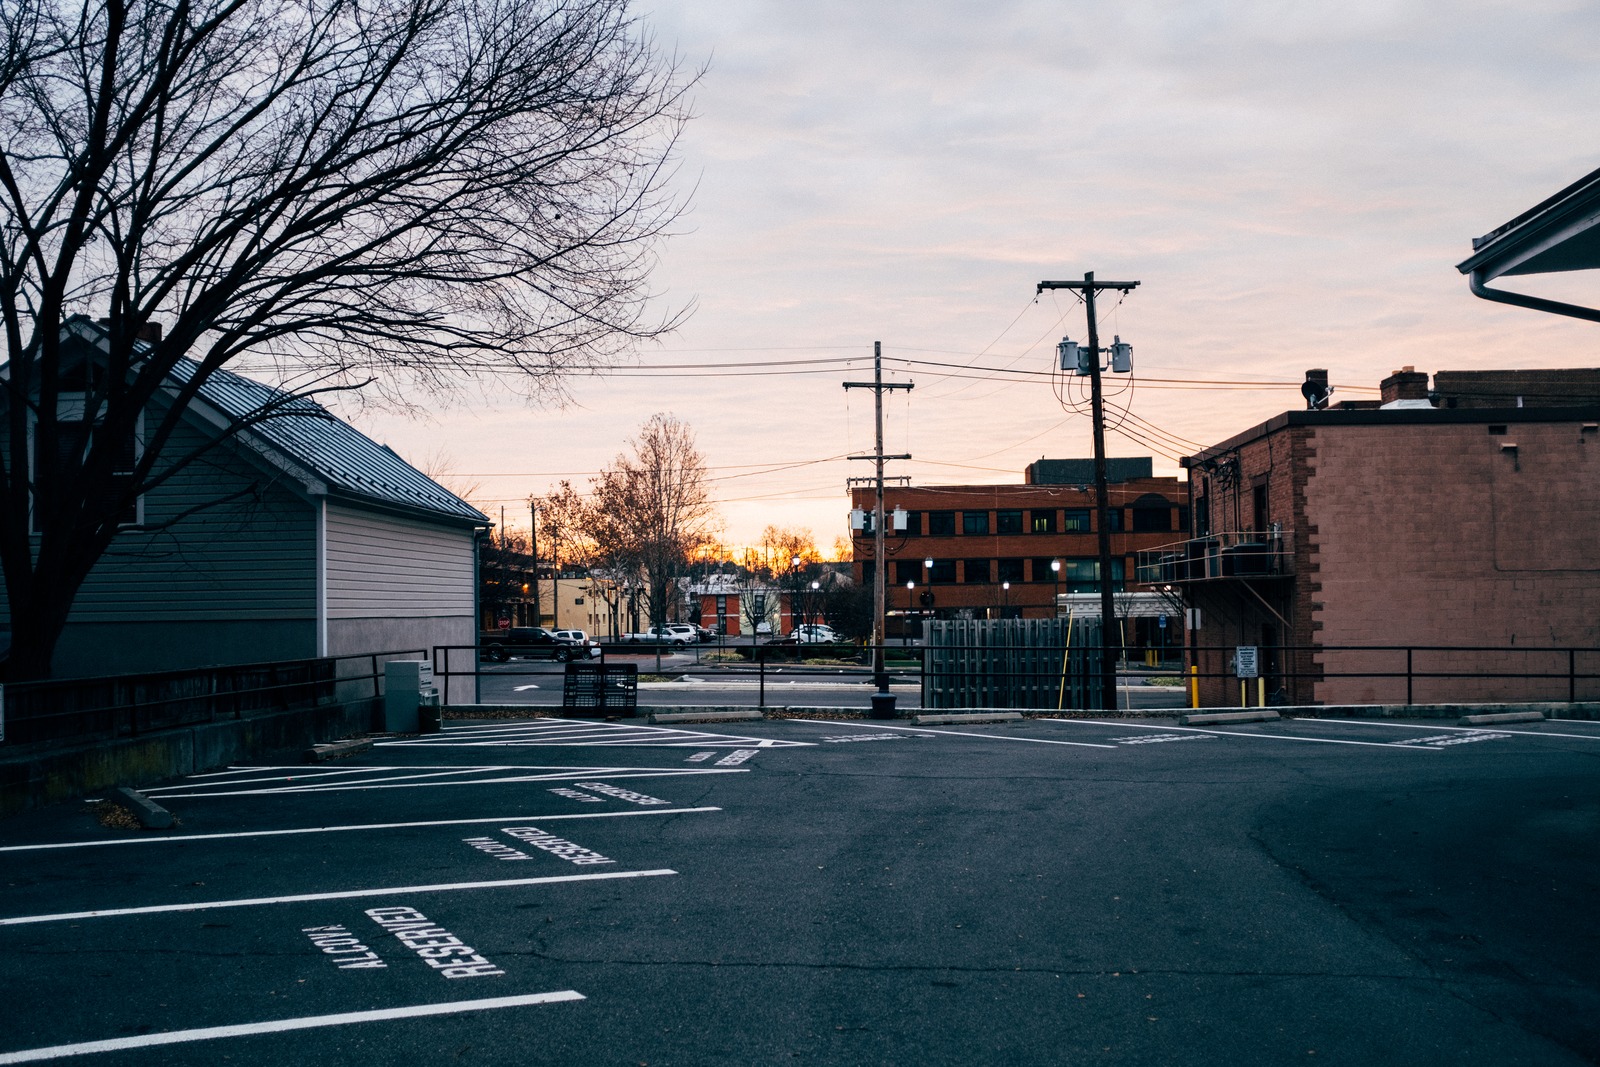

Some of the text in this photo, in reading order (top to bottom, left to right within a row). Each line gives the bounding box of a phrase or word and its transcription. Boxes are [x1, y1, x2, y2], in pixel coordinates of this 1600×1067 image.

[462, 836, 533, 861] ALCOVA
[501, 827, 617, 866] RESERVED
[301, 924, 388, 969] ALCOVA
[364, 906, 506, 979] RESERVED
